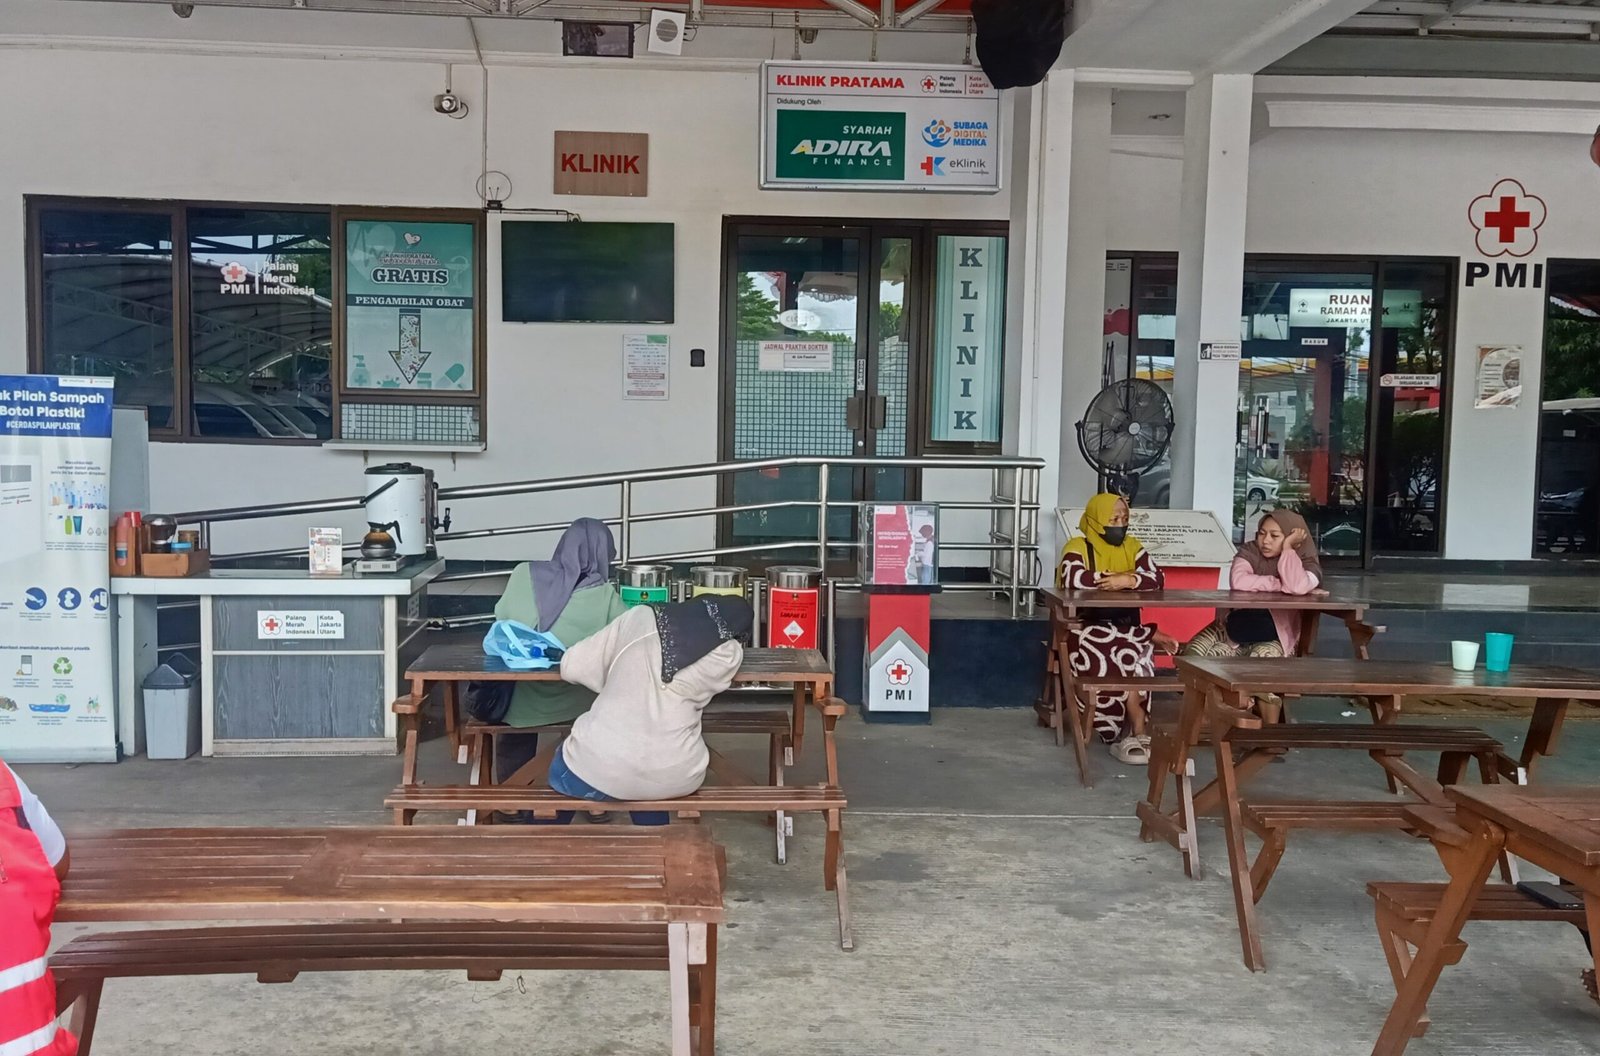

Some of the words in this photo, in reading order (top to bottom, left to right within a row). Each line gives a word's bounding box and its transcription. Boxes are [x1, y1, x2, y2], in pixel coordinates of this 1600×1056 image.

[777, 75, 826, 87] KLINIK
[830, 76, 905, 88] PRATAMA
[777, 98, 806, 106] Didukung
[843, 125, 892, 135] SYARIAH
[953, 121, 988, 130] SUBAGA
[953, 130, 987, 138] DIGITAL
[953, 138, 987, 147] MEDIKA
[790, 139, 892, 157] ADIRA
[561, 153, 640, 175] KLINIK
[813, 158, 892, 166] FINANCE
[949, 159, 986, 168] eKlinik
[263, 261, 299, 273] Palang
[263, 274, 296, 283] Merah
[372, 268, 449, 284] GRATIS
[1464, 262, 1543, 288] PMI
[220, 283, 250, 294] PMI
[263, 285, 315, 295] Indonesia
[355, 296, 433, 306] PENGAMBILAN
[436, 298, 465, 307] OBAT
[1320, 306, 1358, 315] RAMAH
[1360, 306, 1390, 316] ANK
[953, 248, 982, 430] KLINIK
[785, 343, 806, 351] PRAKTIK
[808, 344, 828, 352] DOKTER
[13, 390, 45, 402] Pilah
[49, 391, 105, 405] Sampah
[0, 405, 34, 417] Botol
[37, 406, 85, 418] Plastik!
[6, 420, 81, 430] #CERDASPILAHPLASTIK
[886, 689, 912, 700] PMI
